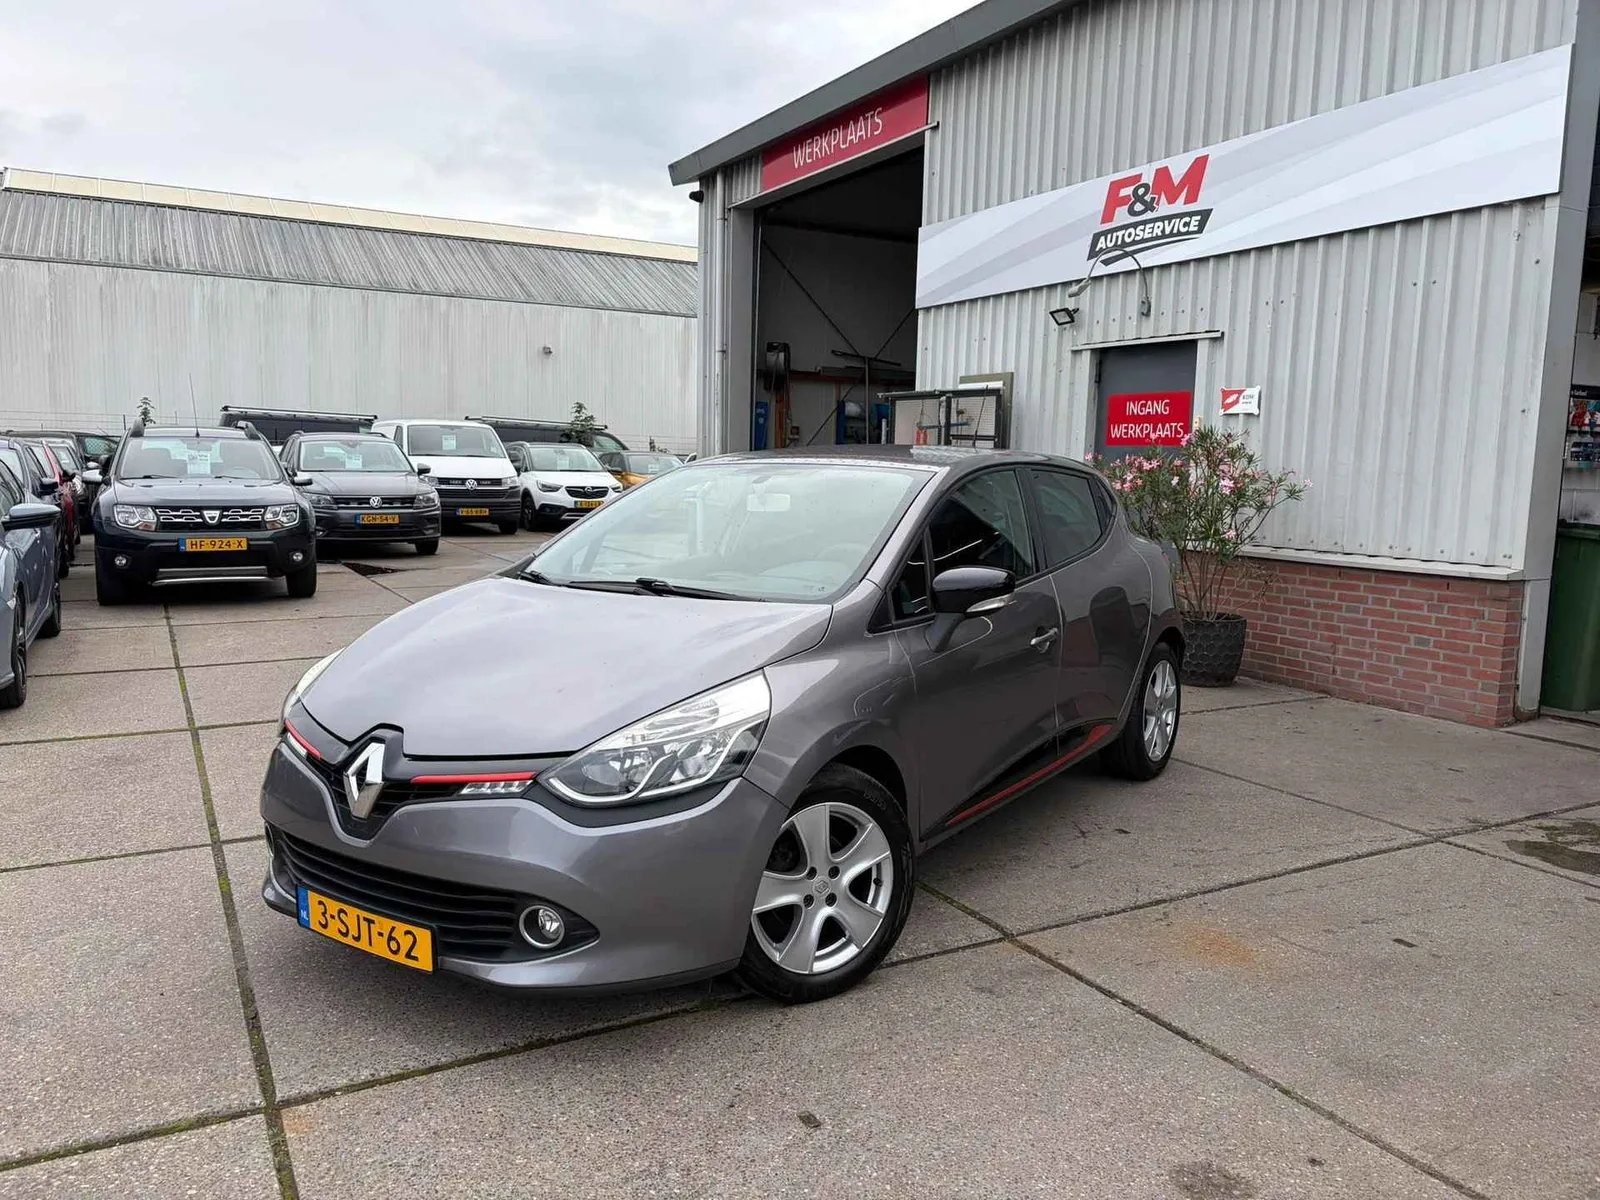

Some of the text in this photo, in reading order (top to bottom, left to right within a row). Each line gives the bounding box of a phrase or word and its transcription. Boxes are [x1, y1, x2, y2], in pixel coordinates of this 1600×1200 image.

[793, 107, 883, 169] WERKPLAATS
[1100, 154, 1210, 225] F&M
[1095, 215, 1201, 252] AUTOSERVICE
[1126, 399, 1170, 416] INGANG
[1110, 422, 1184, 439] WERKPLAATS
[190, 539, 244, 550] HF-924-X
[317, 899, 420, 962] 3-SJT-62
